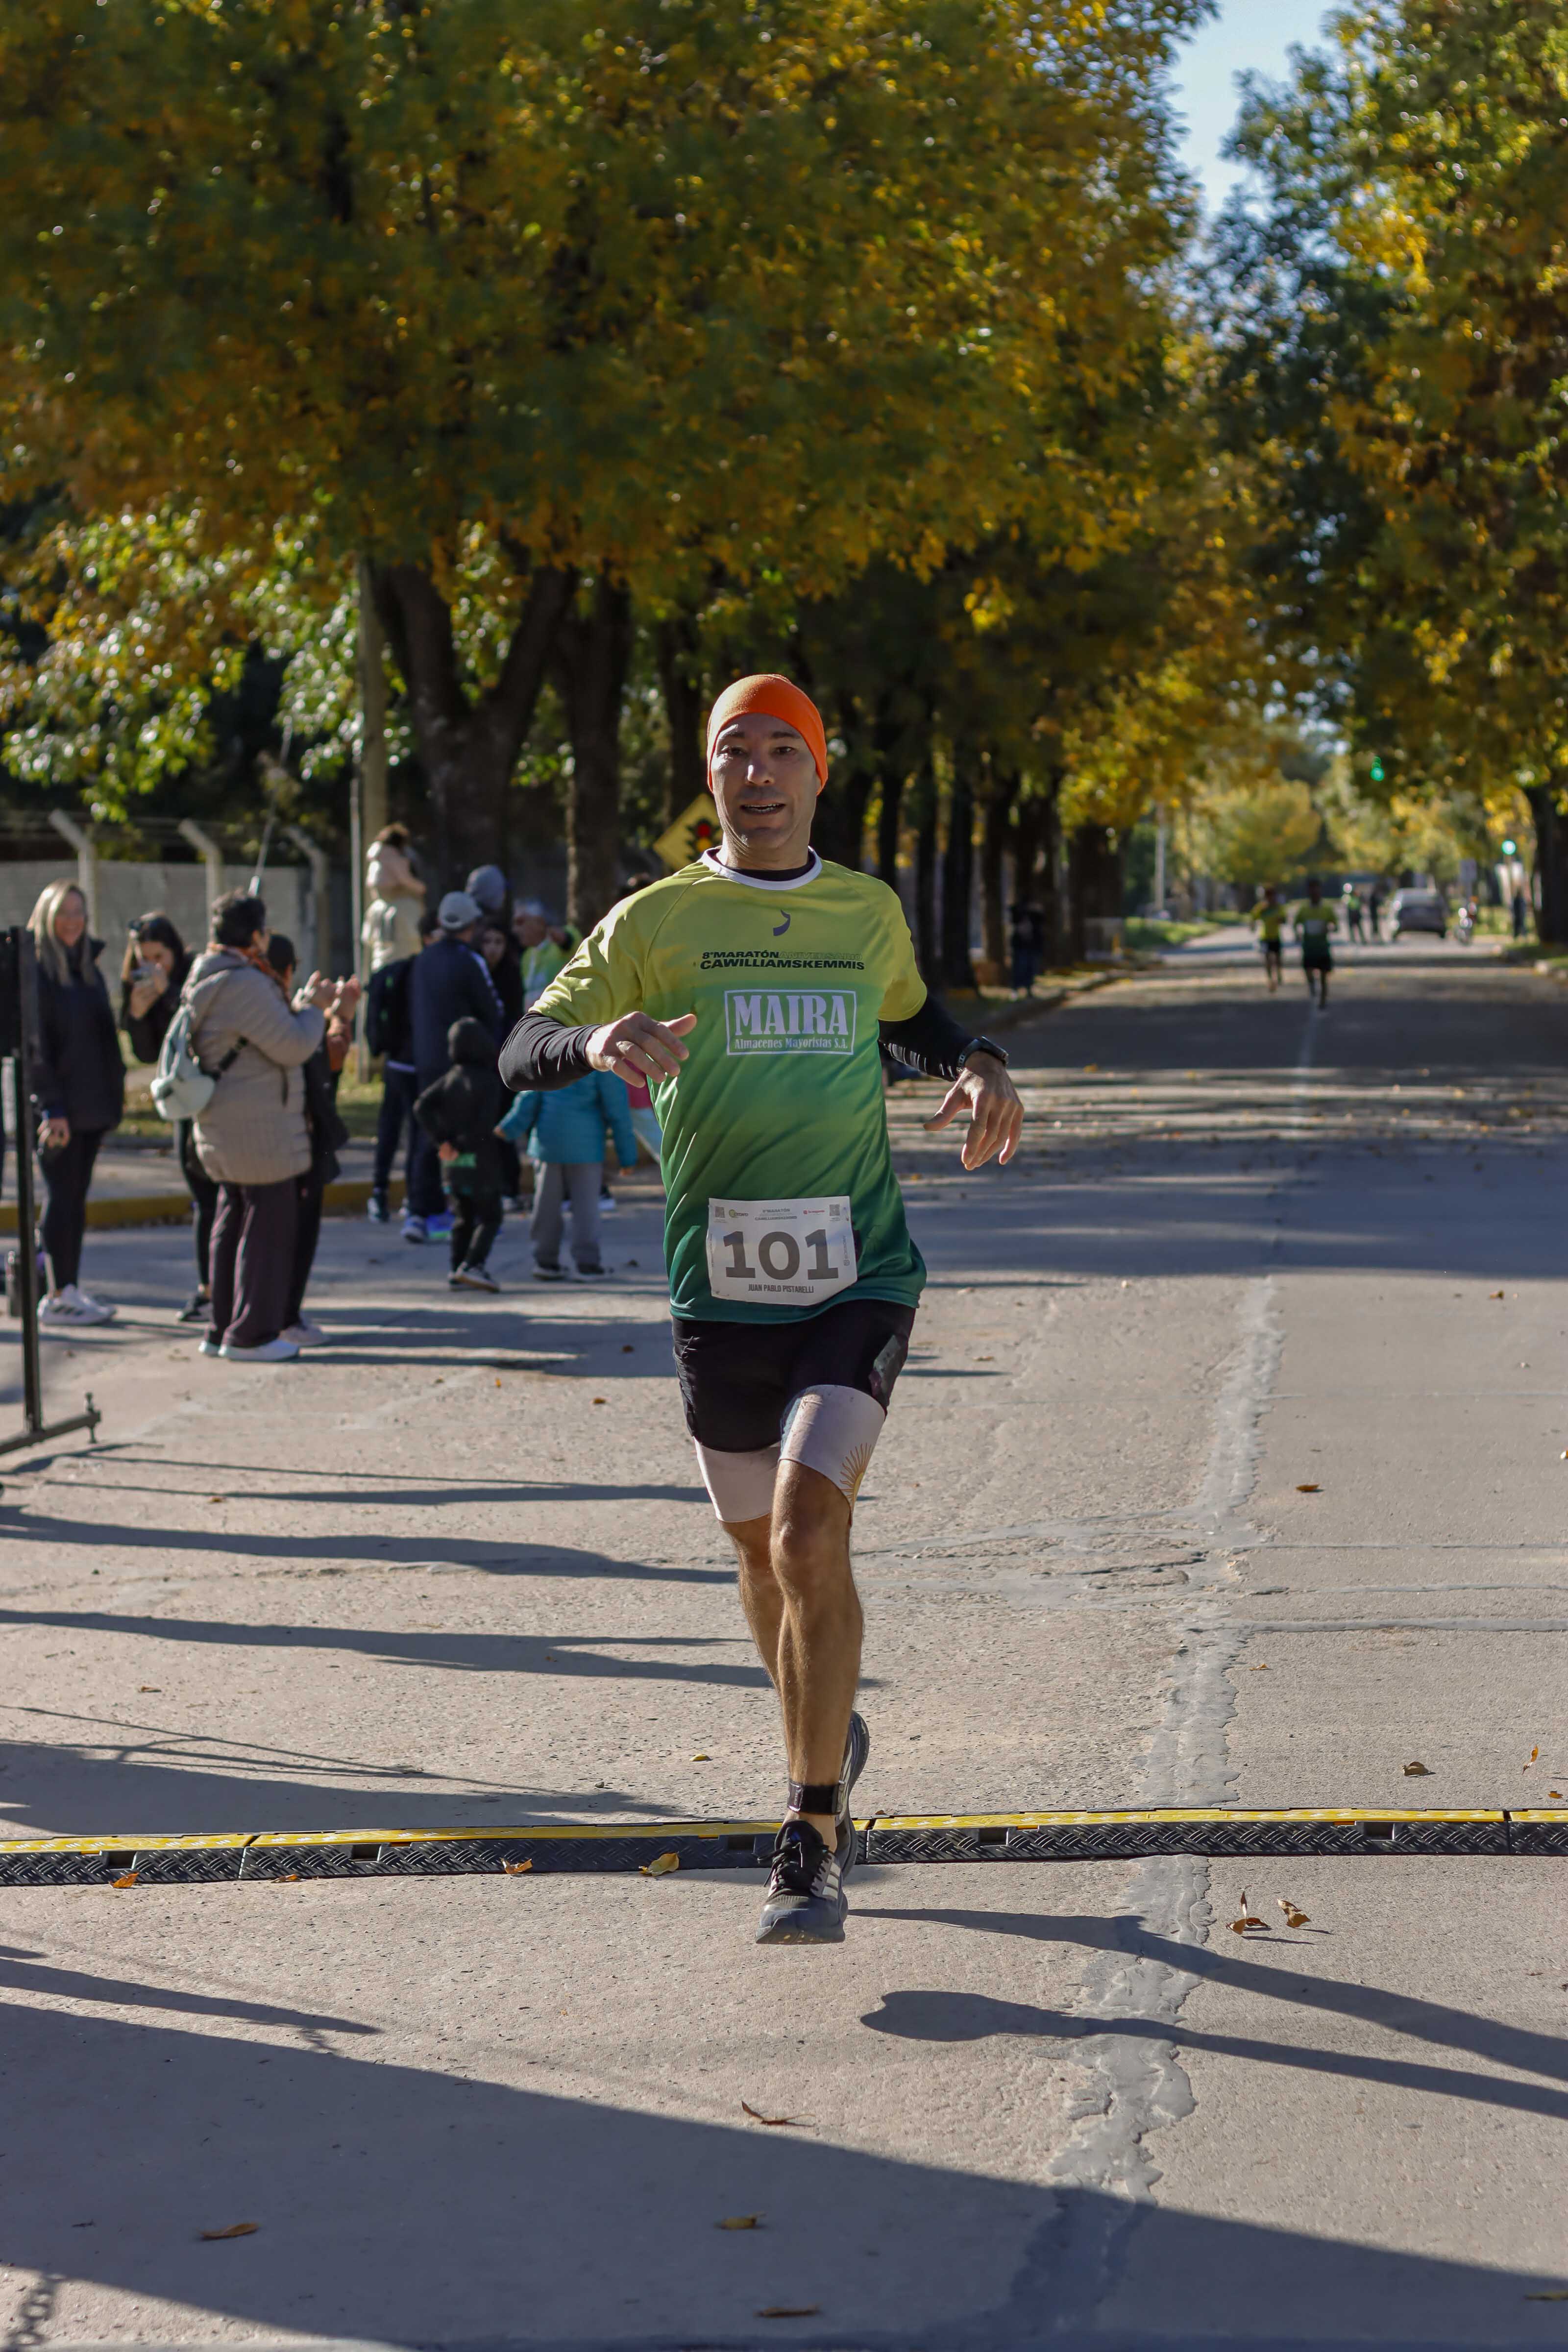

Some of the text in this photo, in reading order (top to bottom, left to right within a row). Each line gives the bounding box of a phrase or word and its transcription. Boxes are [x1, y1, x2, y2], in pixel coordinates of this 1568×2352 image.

[733, 995, 849, 1035] MAIRA
[735, 1037, 848, 1049] Almacenes Mayoristas S.A.
[723, 1229, 838, 1280] 101
